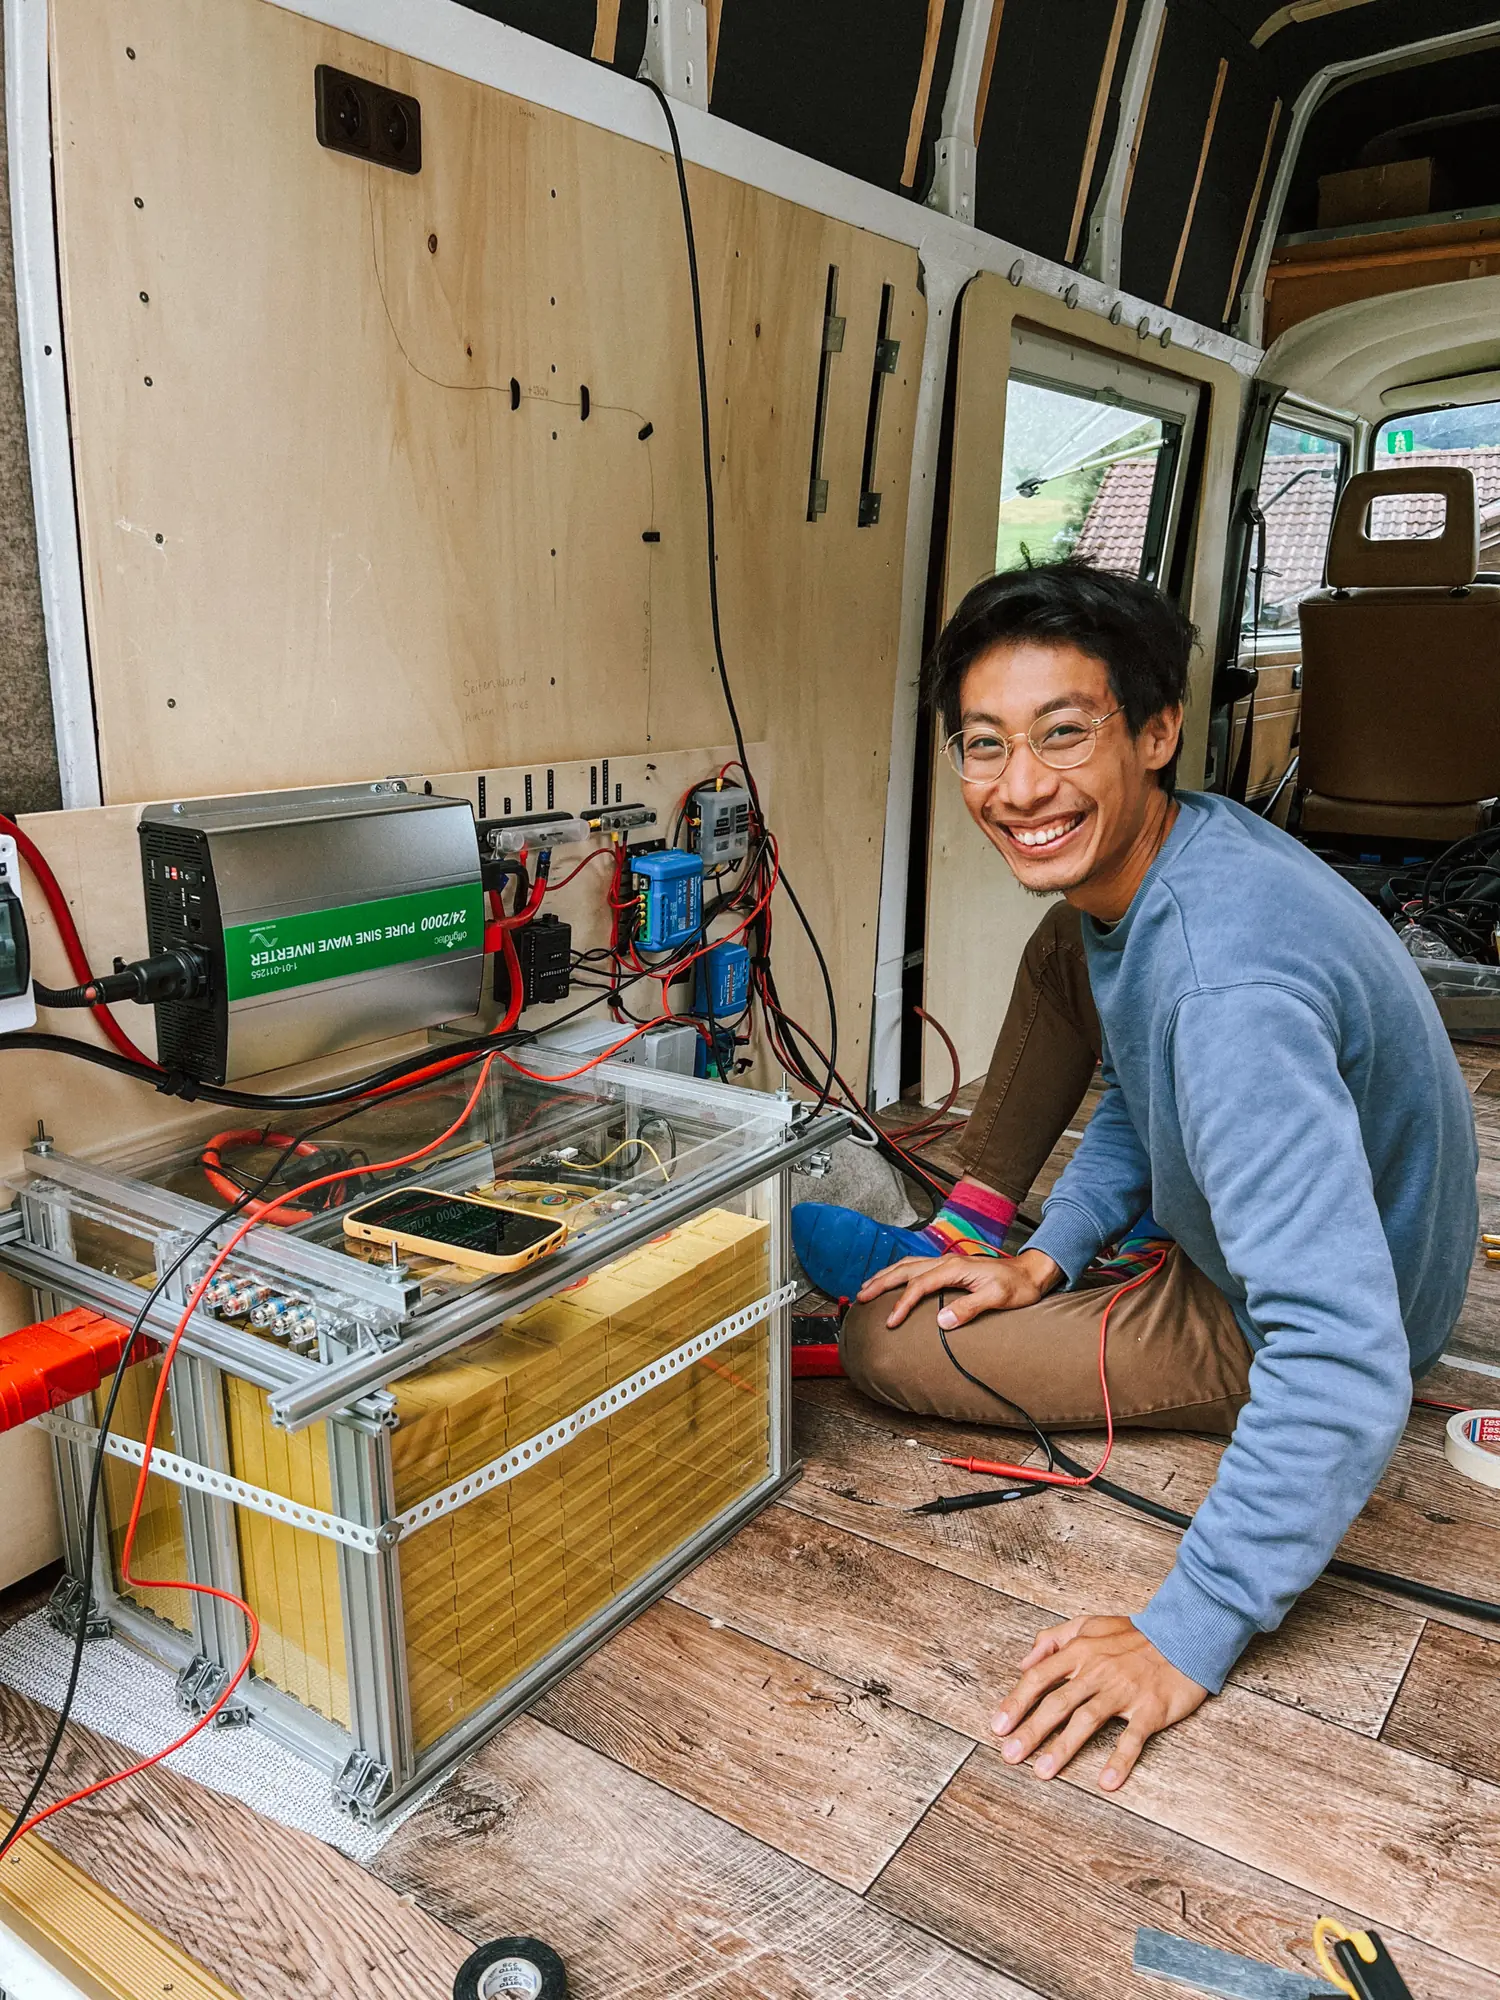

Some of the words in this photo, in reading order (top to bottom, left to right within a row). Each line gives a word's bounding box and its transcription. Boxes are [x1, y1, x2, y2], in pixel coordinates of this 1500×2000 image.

[463, 670, 527, 697] Seitenwand
[420, 909, 467, 931] 24/2000
[355, 928, 383, 945] SINE
[384, 921, 416, 939] PURE
[434, 930, 468, 947] offgridtec
[318, 934, 353, 952] WAVE
[250, 941, 316, 966] INVERTER
[251, 962, 298, 980] 1-01-011255
[1481, 1433, 1500, 1441] tes
